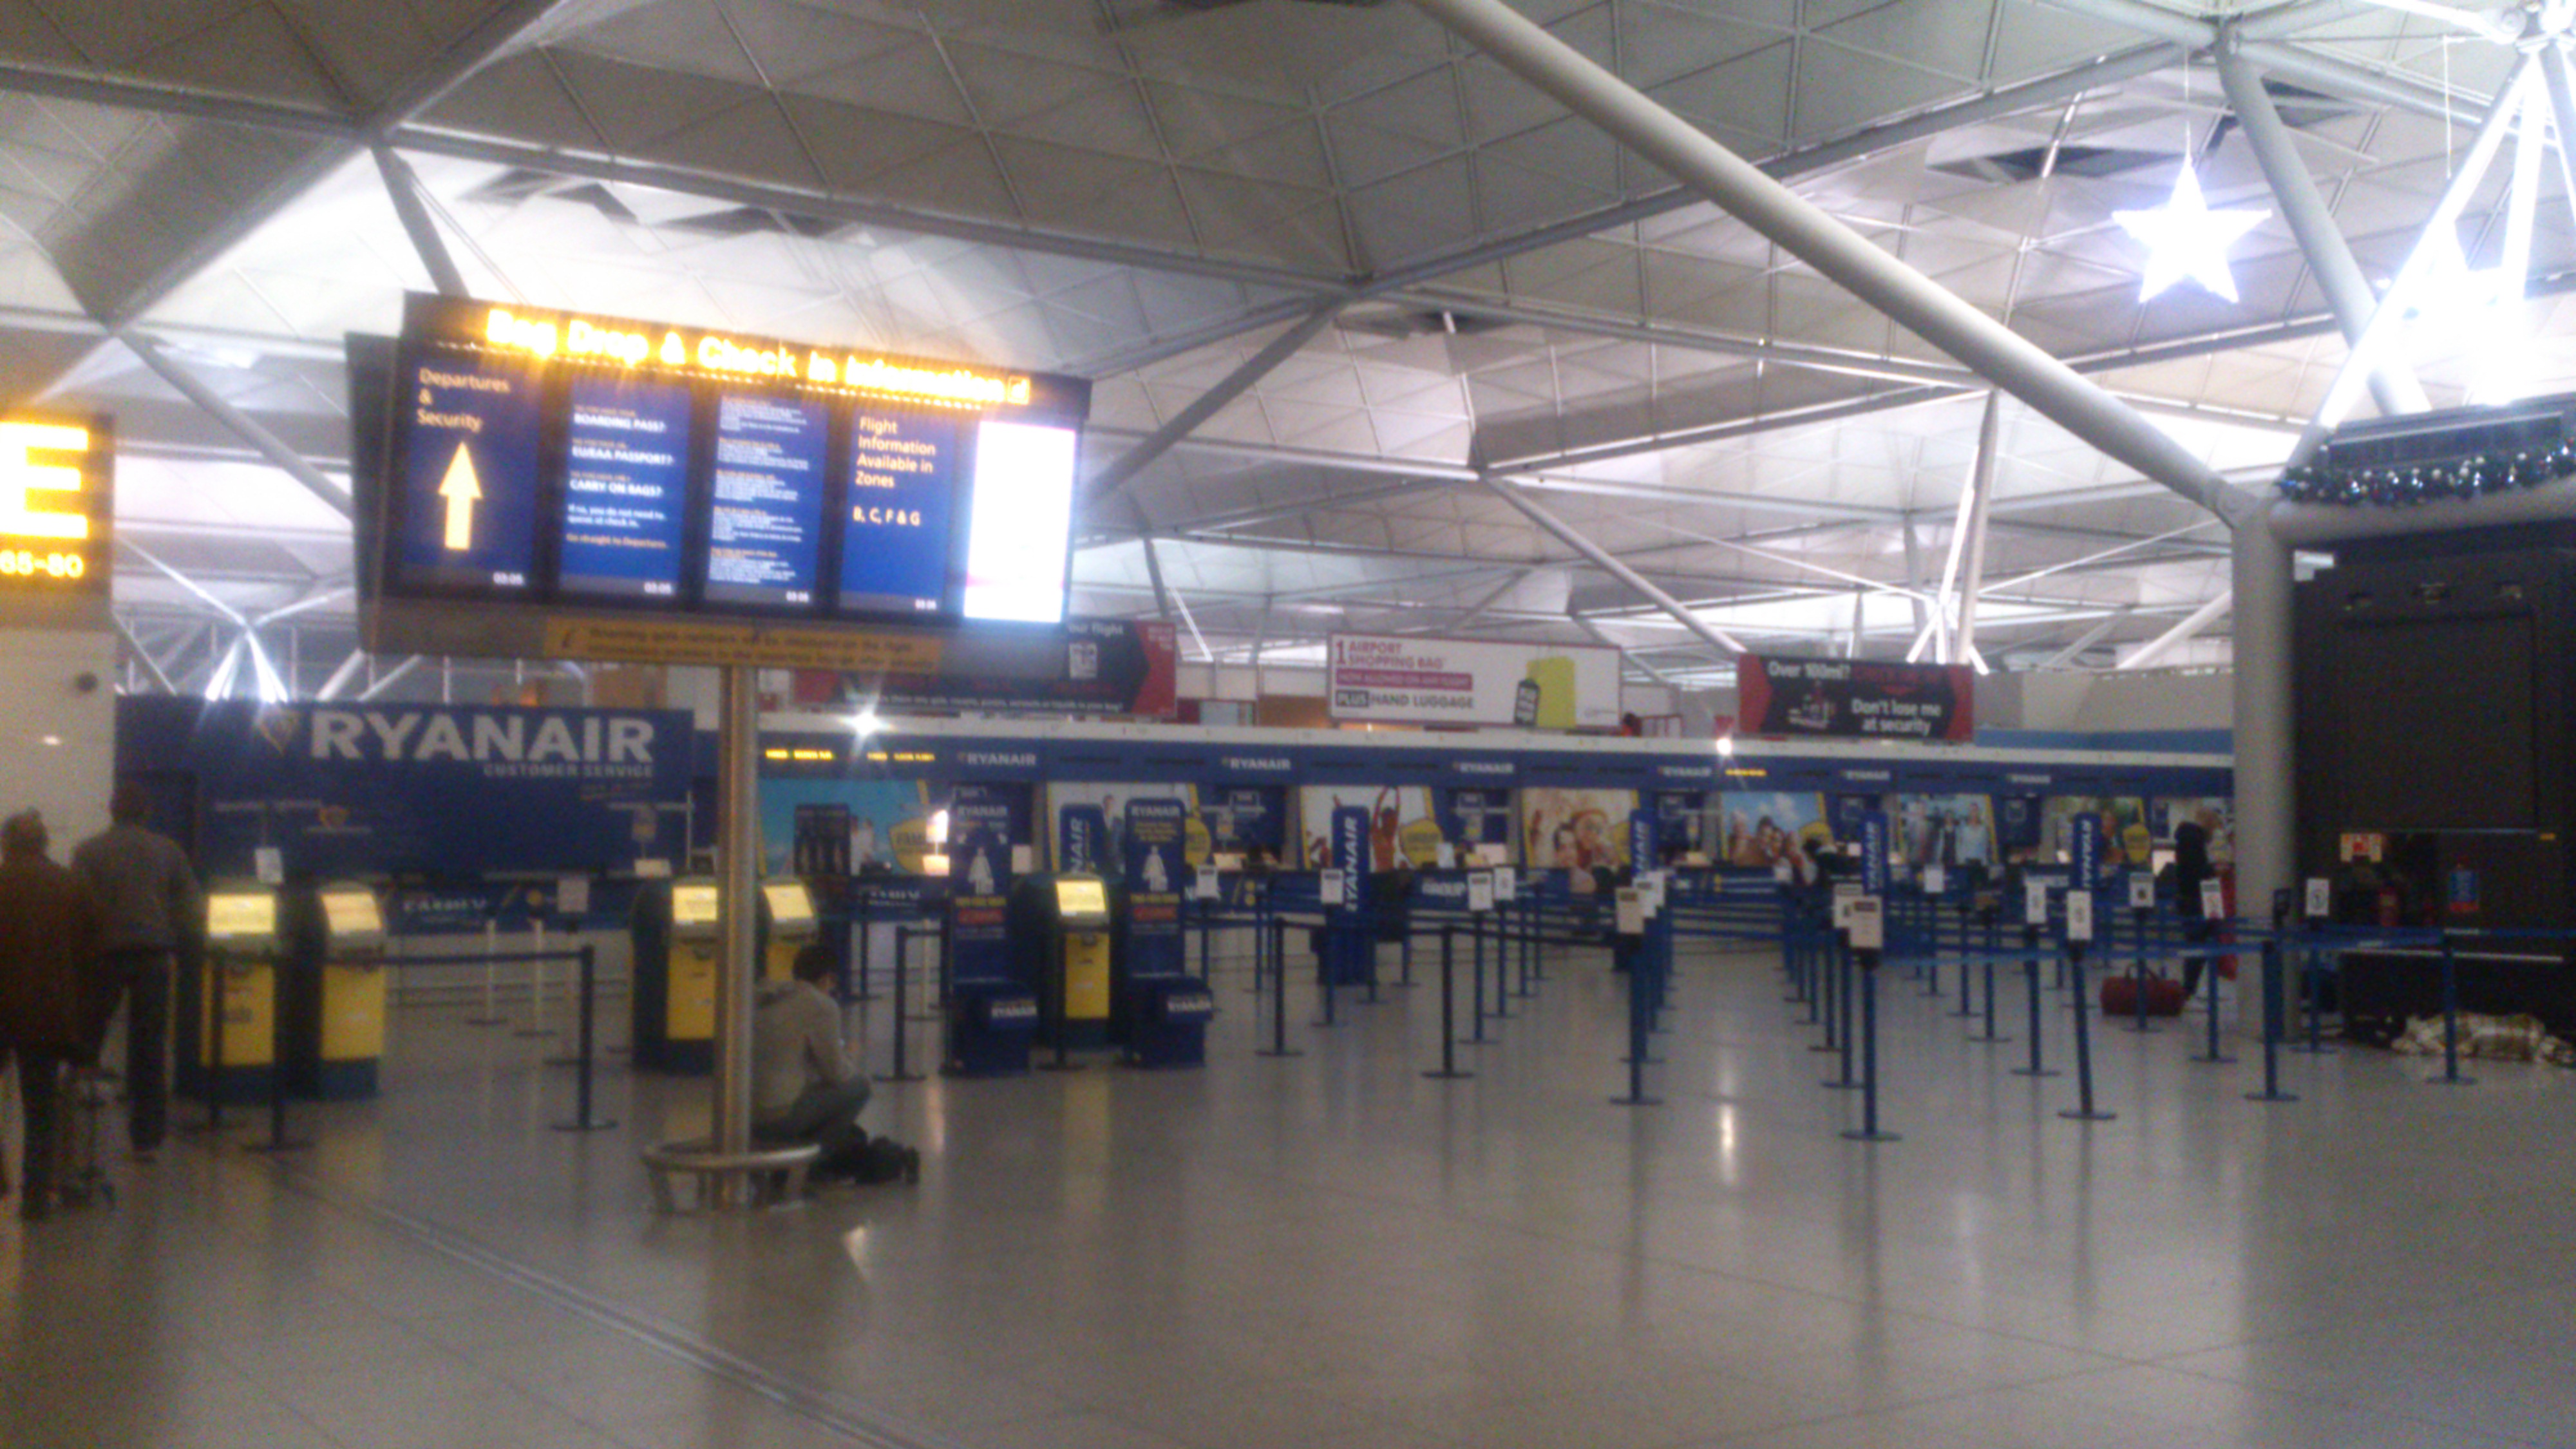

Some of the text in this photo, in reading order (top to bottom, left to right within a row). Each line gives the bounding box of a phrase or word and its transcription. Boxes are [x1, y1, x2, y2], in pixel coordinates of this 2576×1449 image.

[567, 318, 649, 368] Drop
[660, 330, 686, 365] &
[697, 335, 797, 378] Check
[807, 350, 837, 383] In
[844, 354, 1005, 403] Information
[419, 366, 511, 393] Departures
[419, 388, 433, 405] &
[417, 408, 482, 434] Security
[573, 412, 667, 433] BOARDING PASS?
[859, 415, 898, 436] Flight
[857, 433, 936, 456] Information
[614, 450, 674, 466] PASSPORT?
[856, 452, 934, 474] Available in
[0, 421, 89, 539] E
[569, 478, 663, 498] CARRY ON BAGS?
[855, 469, 895, 489] Zones
[853, 506, 921, 527] B, C, F & G
[1336, 640, 1346, 665] 1
[1349, 641, 1403, 654] AIRPORT
[1349, 654, 1415, 668] SHOPPING
[1766, 660, 1801, 677] Over
[1370, 693, 1410, 707] HAND
[1414, 695, 1474, 710] LUGGAGE
[1850, 697, 1942, 717] Don't lose me
[310, 710, 655, 763] RYANAIR
[1862, 717, 1931, 737] at security
[967, 752, 1036, 766] RYANAIR
[1230, 757, 1292, 771] RYANAIR
[1459, 761, 1515, 774] RYANAIR
[483, 763, 654, 779] CUSTOMER SERVICE
[957, 805, 1009, 818] RYANAIR
[1130, 805, 1182, 818] RYANAIR
